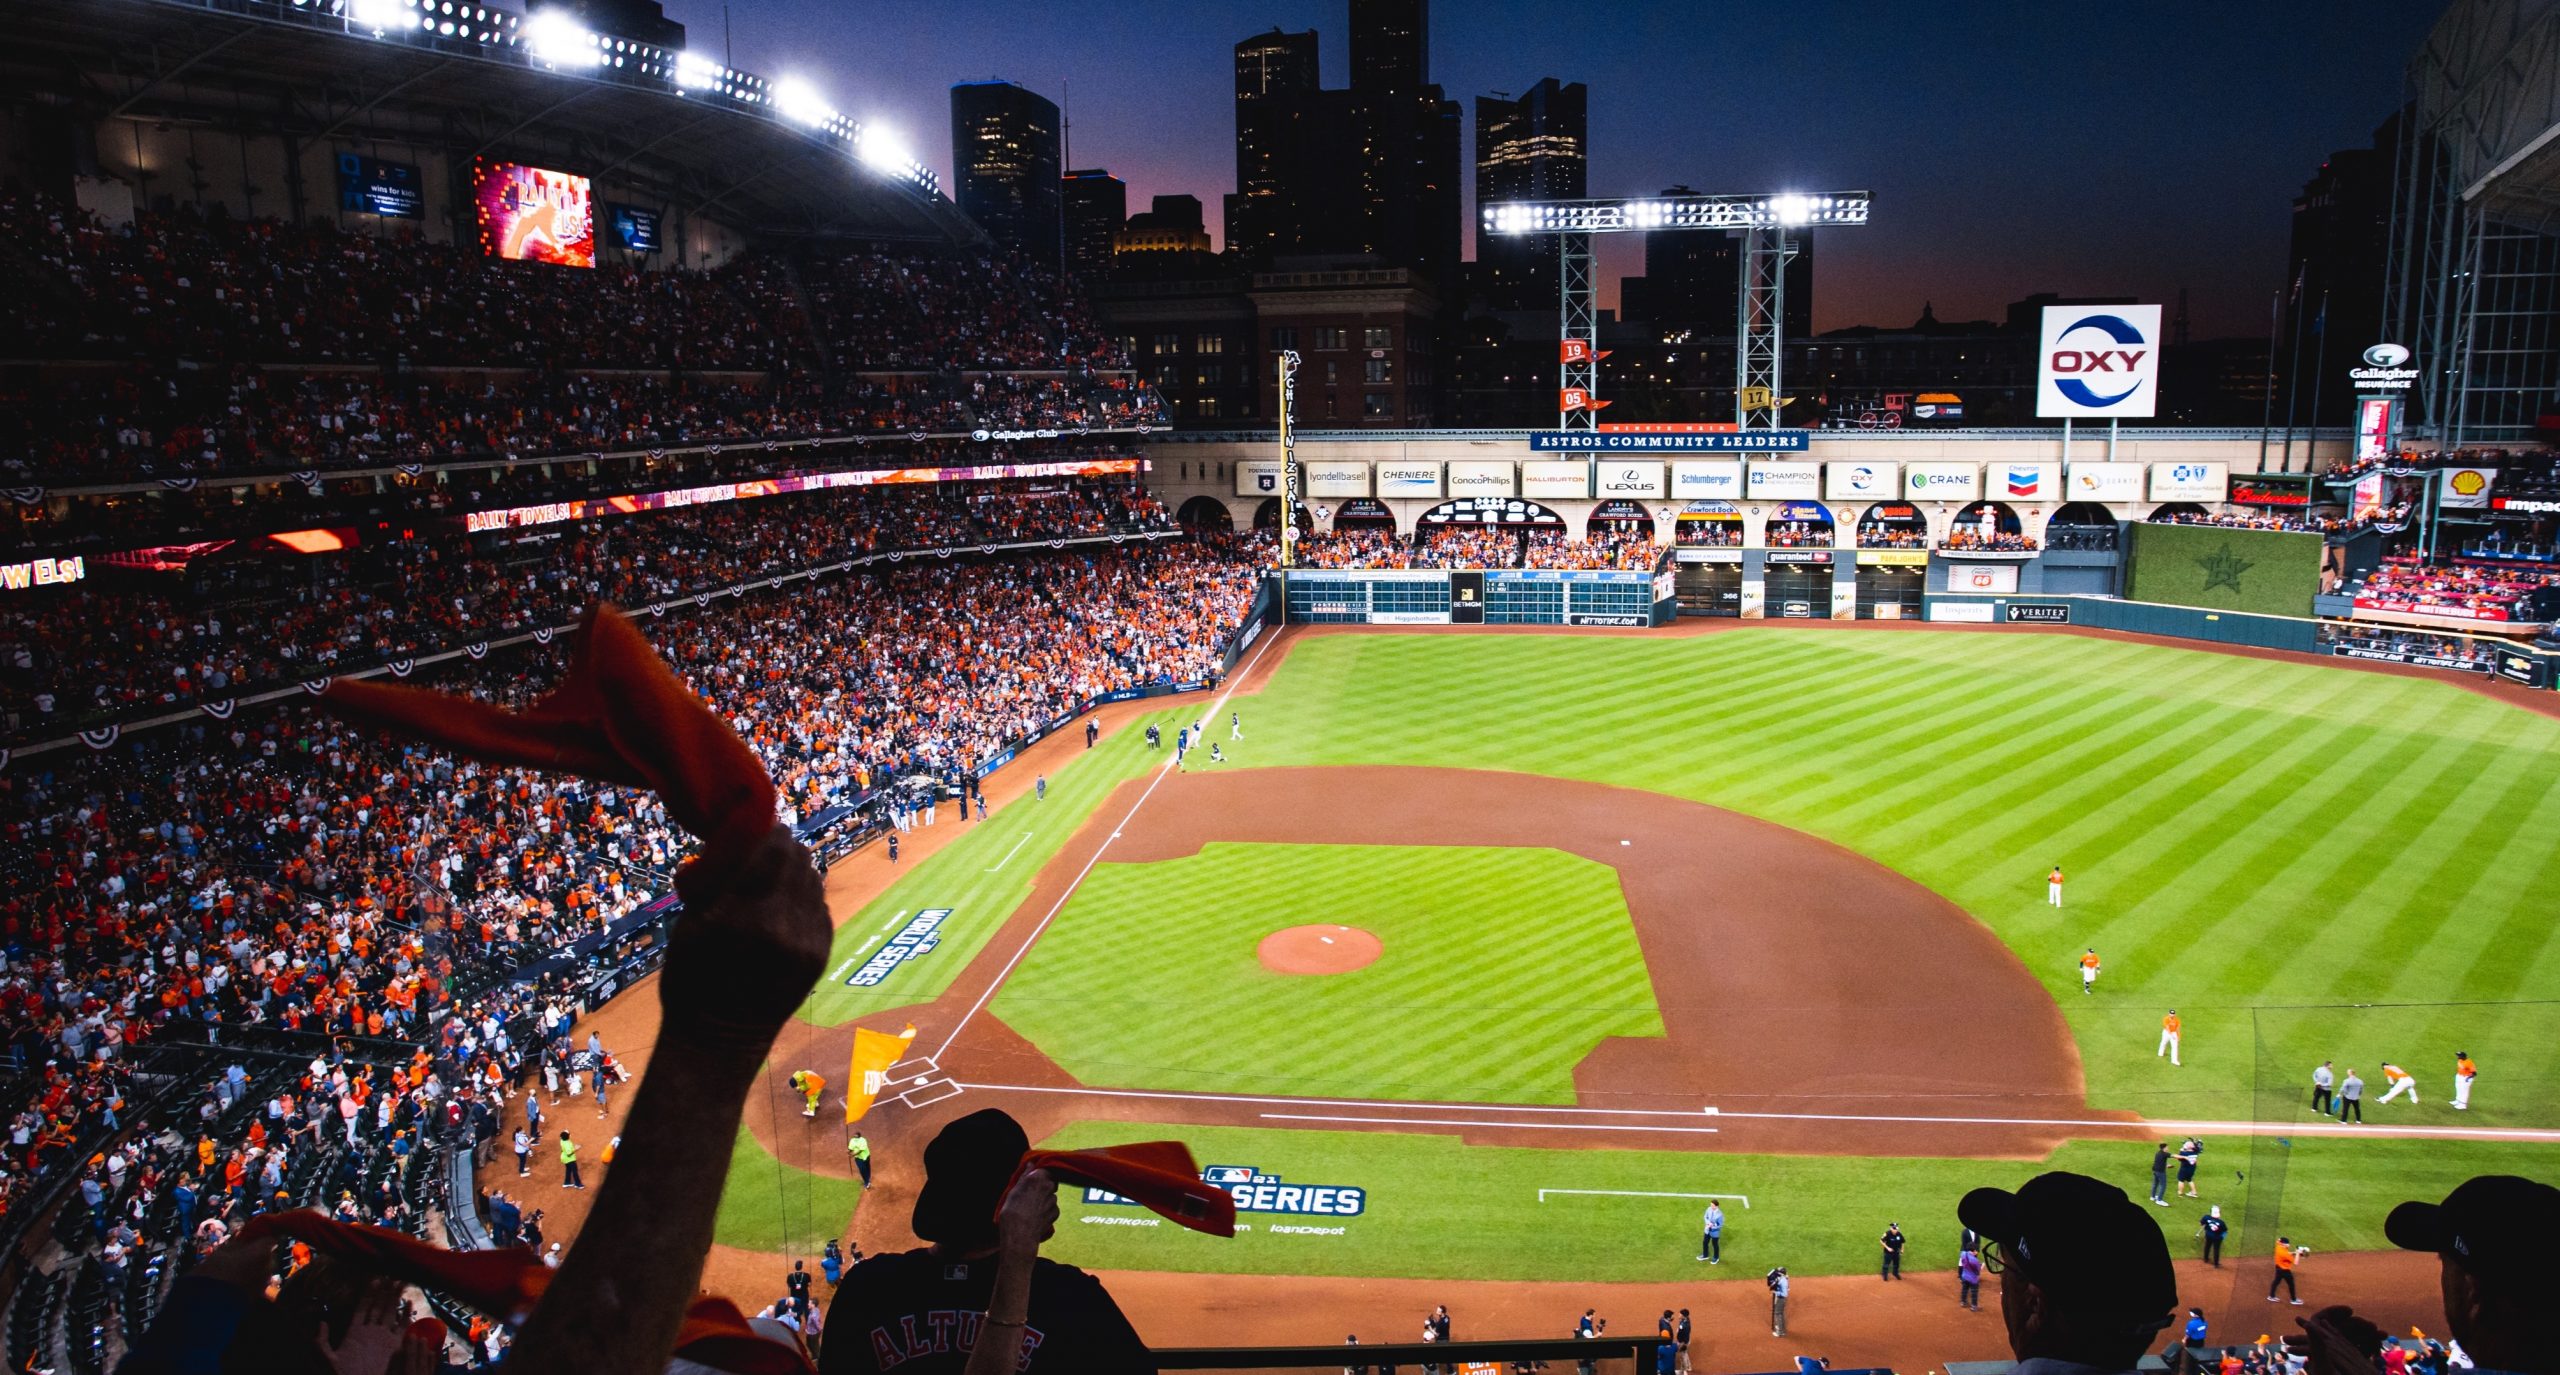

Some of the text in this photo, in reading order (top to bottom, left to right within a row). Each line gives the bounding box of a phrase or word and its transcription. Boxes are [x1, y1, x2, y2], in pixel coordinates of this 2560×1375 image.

[371, 185, 388, 193] wins
[389, 187, 400, 195] for
[1567, 345, 1581, 356] 19
[2052, 351, 2147, 372] OXY
[2349, 368, 2419, 380] Gallagher
[2354, 380, 2411, 388] INSURANCE
[1566, 393, 1581, 404] 05
[1748, 392, 1763, 403] 17
[992, 429, 1058, 442] Gallagher Club
[1609, 436, 1715, 447] COMMUNITY
[1723, 436, 1798, 446] LEADERS
[1309, 471, 1366, 482] lyondellbasell
[1383, 471, 1435, 479] CHENIERE
[1452, 476, 1510, 485] ConocoPhillips
[1681, 474, 1732, 485] Schlumberger
[1929, 475, 1970, 484] CRANE
[467, 503, 571, 532] RALLY TOWELS!
[1771, 552, 1812, 561] guaranteed
[1974, 576, 1991, 586] 66
[2022, 608, 2066, 616] VERITEX
[1580, 615, 1637, 626] NITTOTIRE.COM
[892, 909, 951, 945] WORLD
[848, 945, 910, 985] SERIES
[1231, 1185, 1361, 1214] SERIES
[1270, 1223, 1345, 1235] loanDepot
[870, 1309, 1045, 1372] ALTUE
